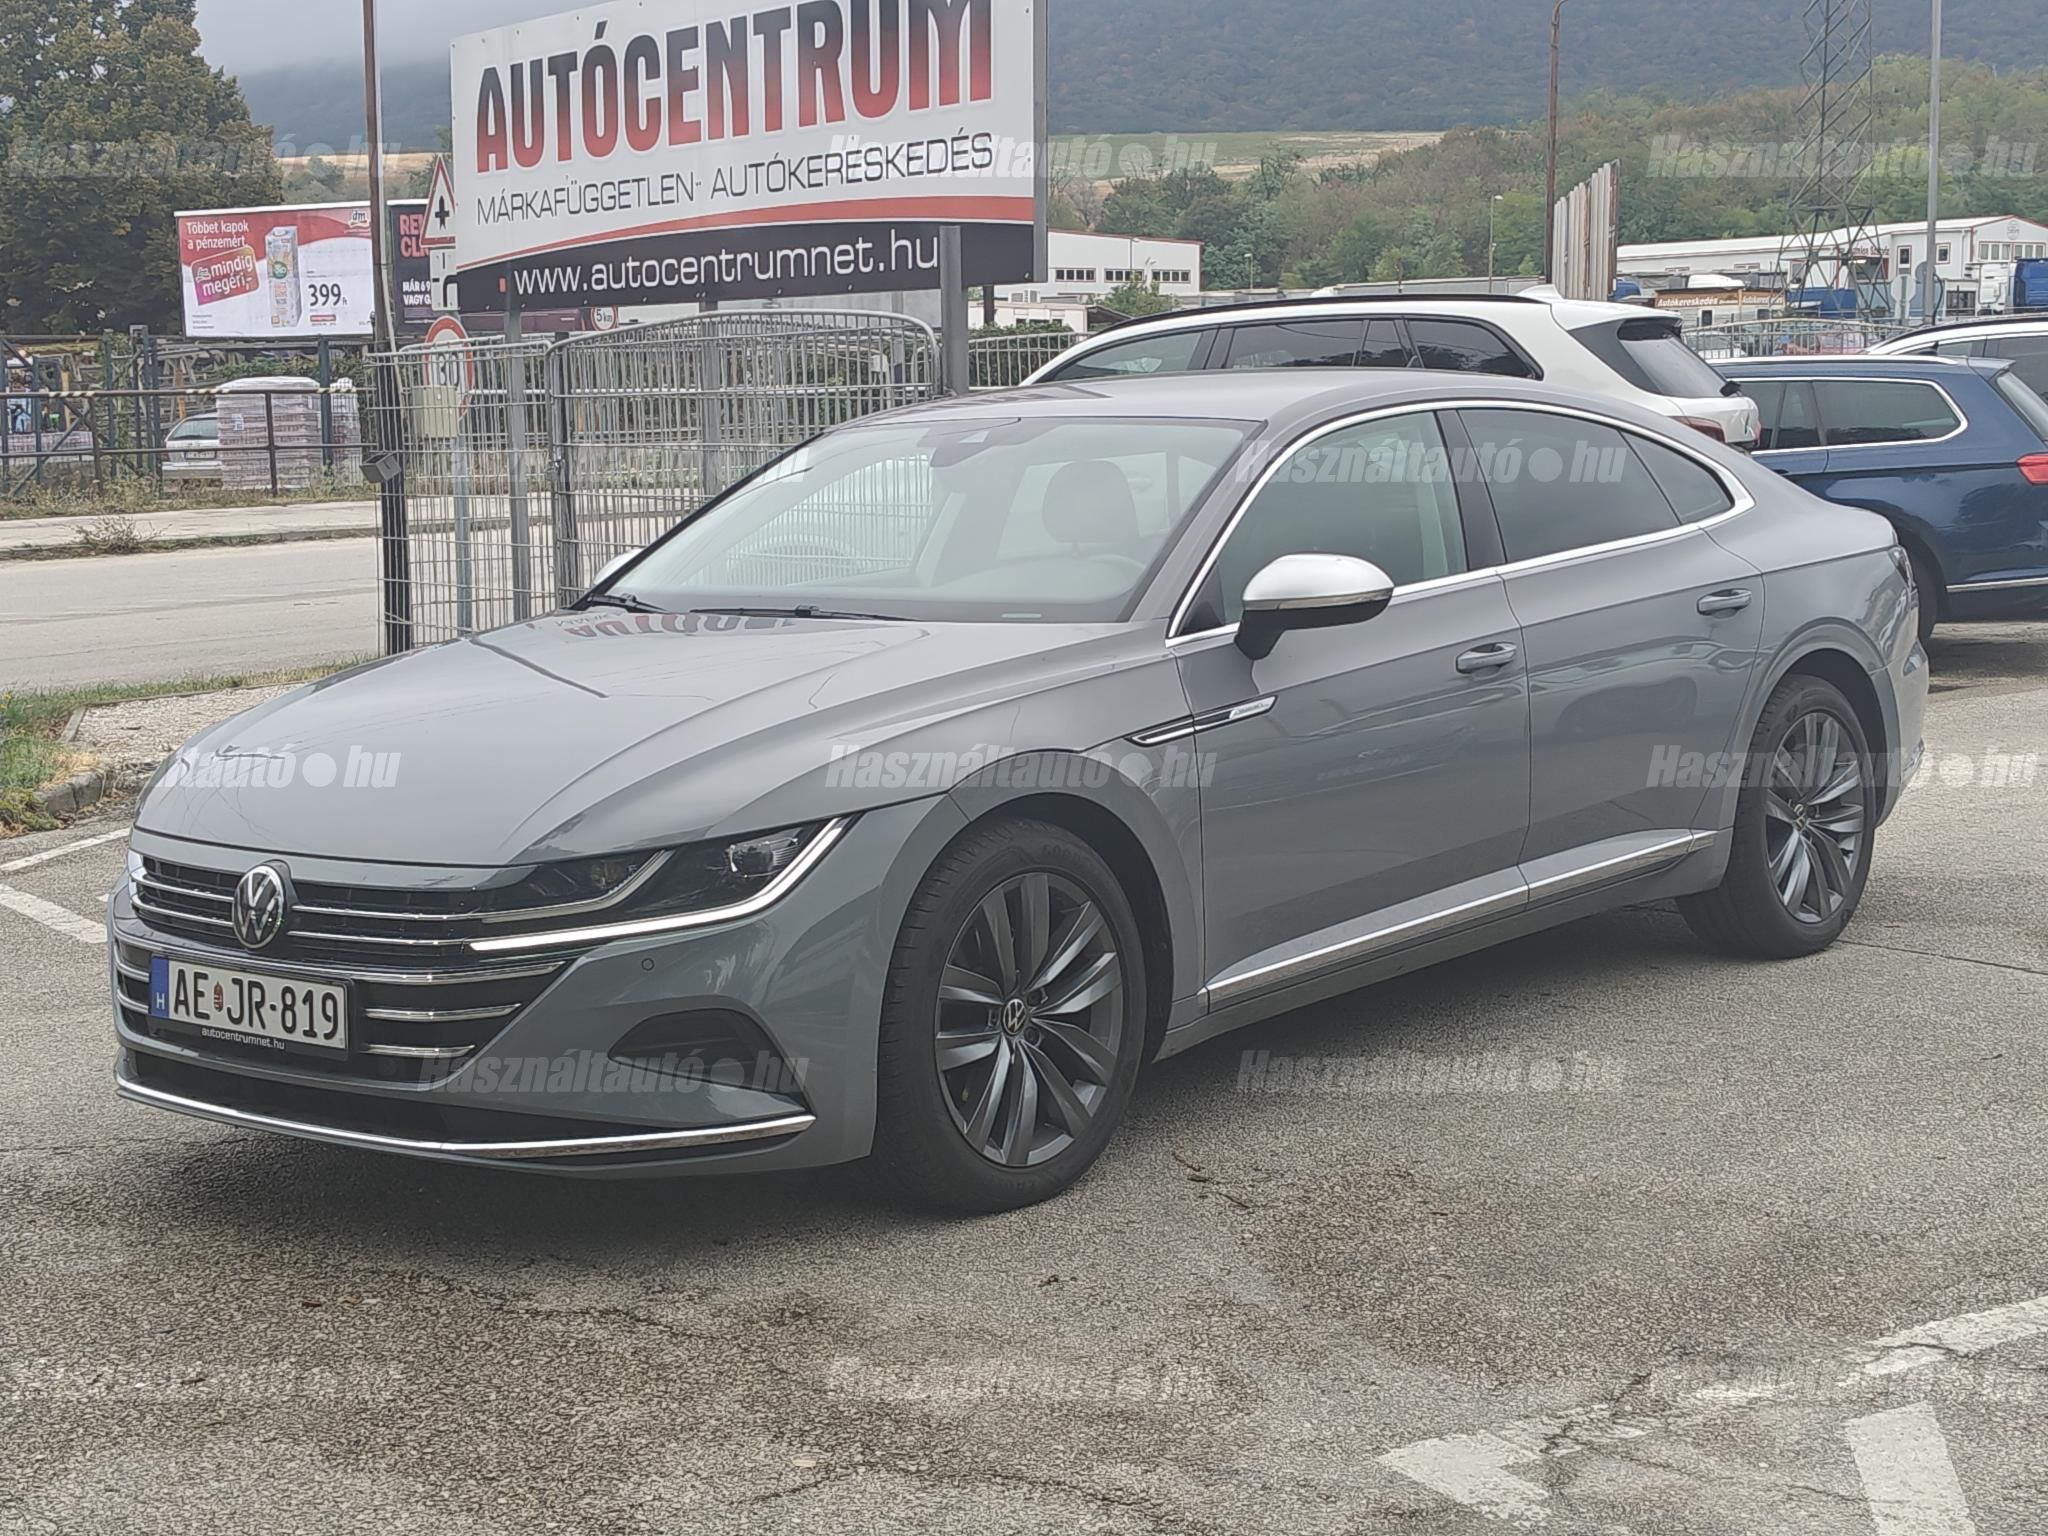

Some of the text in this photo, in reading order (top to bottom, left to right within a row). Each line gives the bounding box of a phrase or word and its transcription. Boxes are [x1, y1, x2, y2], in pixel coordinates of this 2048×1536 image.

[476, 0, 993, 174] AUTÓCENTRUM
[709, 127, 993, 200] AUTÓKERESKEDÉS
[186, 219, 249, 236] Többet kapok
[399, 214, 424, 235] RE
[187, 239, 194, 250] a
[210, 255, 253, 278] mindig
[514, 228, 939, 297] www.autocentrumnet.hu
[308, 283, 341, 307] 399
[402, 278, 420, 293] MÁR
[403, 294, 423, 306] VAGY
[596, 308, 603, 322] 5
[156, 991, 166, 1011] H
[201, 1026, 286, 1051] autocentrumnet.hu
